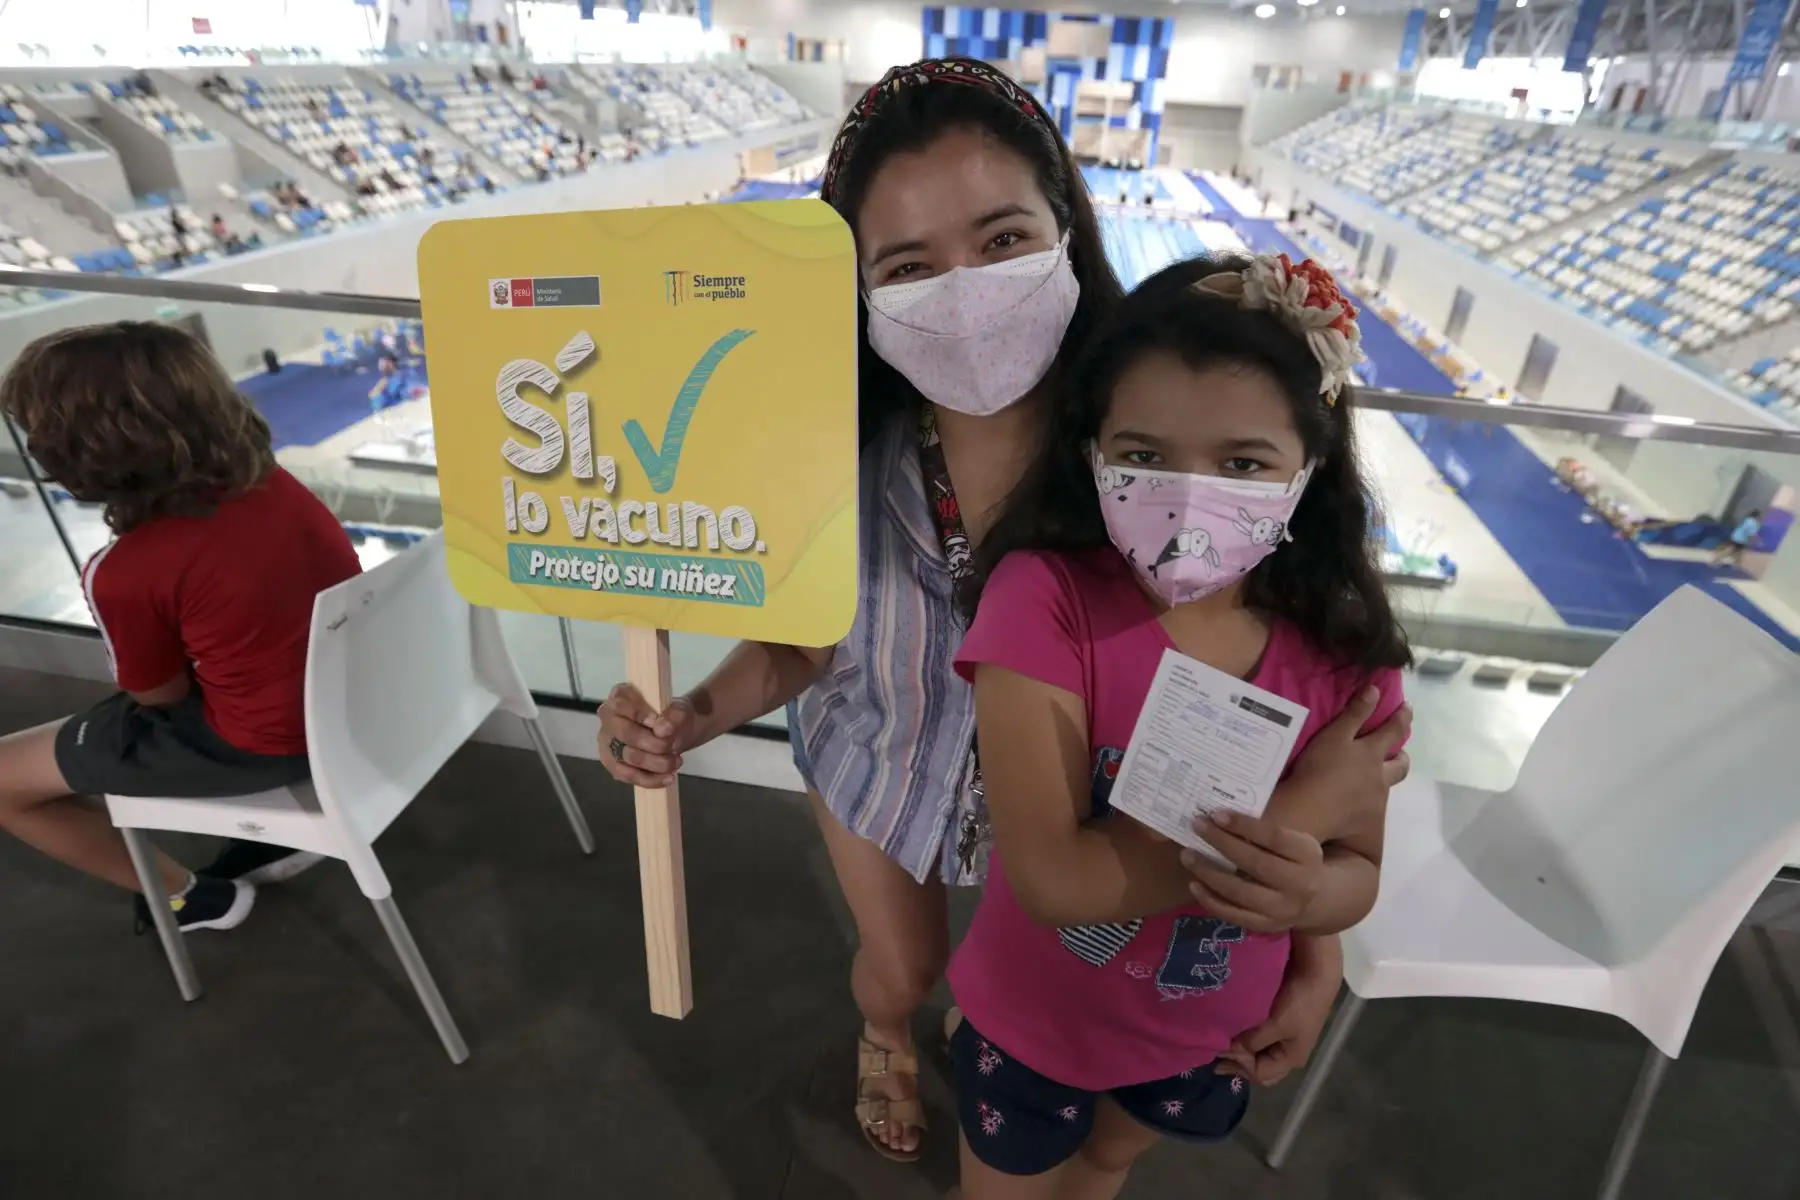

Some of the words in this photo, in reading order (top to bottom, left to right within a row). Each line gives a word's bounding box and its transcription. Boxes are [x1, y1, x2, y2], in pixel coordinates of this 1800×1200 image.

[512, 286, 531, 297] PERÚ
[693, 274, 746, 290] Siempre
[712, 287, 746, 302] pueblo
[495, 329, 617, 494] Sí,
[502, 476, 549, 533] lo
[559, 496, 767, 553] vacuno.
[529, 549, 620, 591] Protejo
[624, 564, 656, 589] su
[660, 562, 737, 597] niñez
